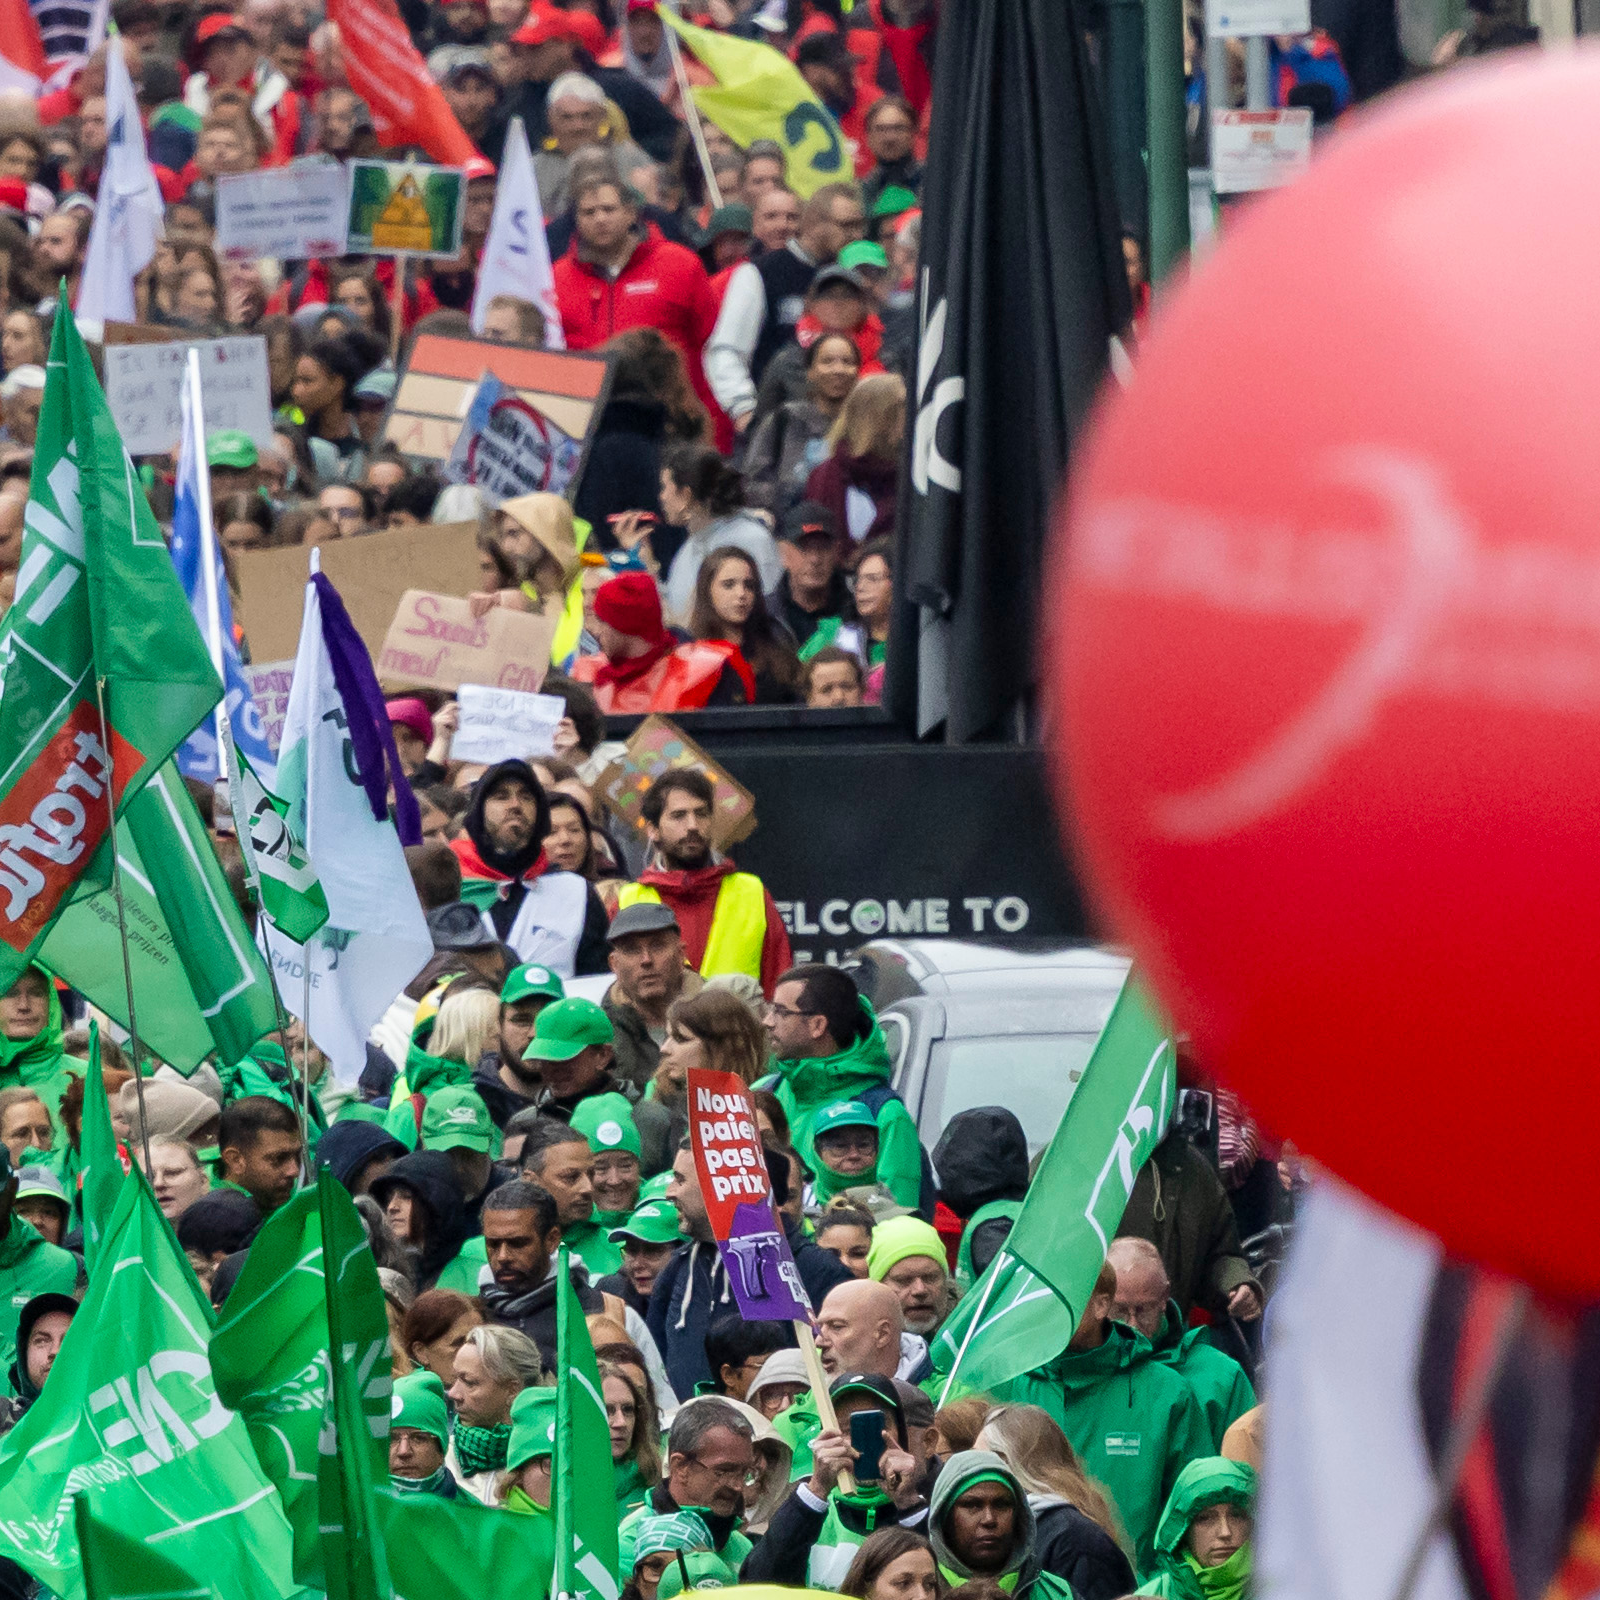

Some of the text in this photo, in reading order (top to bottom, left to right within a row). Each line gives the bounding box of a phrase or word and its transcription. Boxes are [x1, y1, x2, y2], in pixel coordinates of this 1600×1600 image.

[963, 896, 1030, 933] TO
[127, 931, 170, 965] prijzen
[704, 1147, 756, 1184] pas
[711, 1166, 767, 1202] prix
